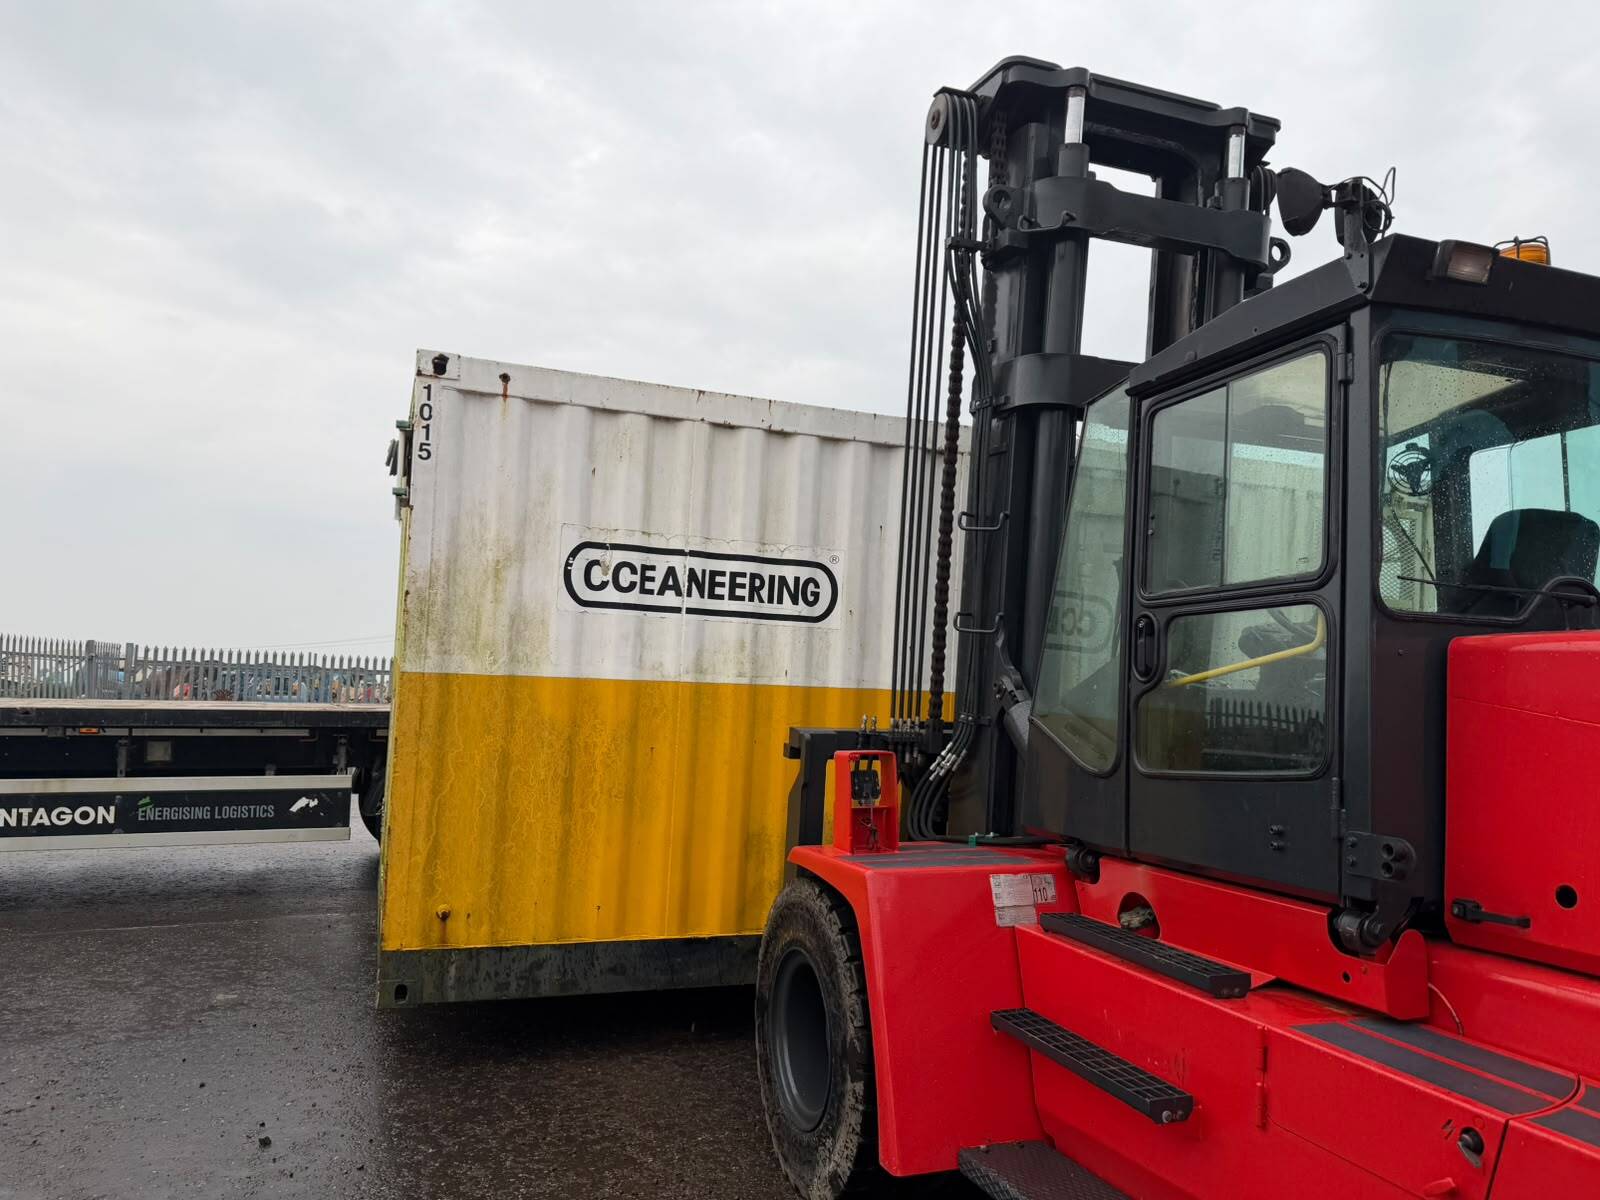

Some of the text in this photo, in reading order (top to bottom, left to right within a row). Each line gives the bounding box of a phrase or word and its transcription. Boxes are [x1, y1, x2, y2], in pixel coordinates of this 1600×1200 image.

[417, 383, 433, 461] 1015
[0, 805, 116, 828] NTAGON
[138, 804, 275, 821] ENERGISING LOGISTICS
